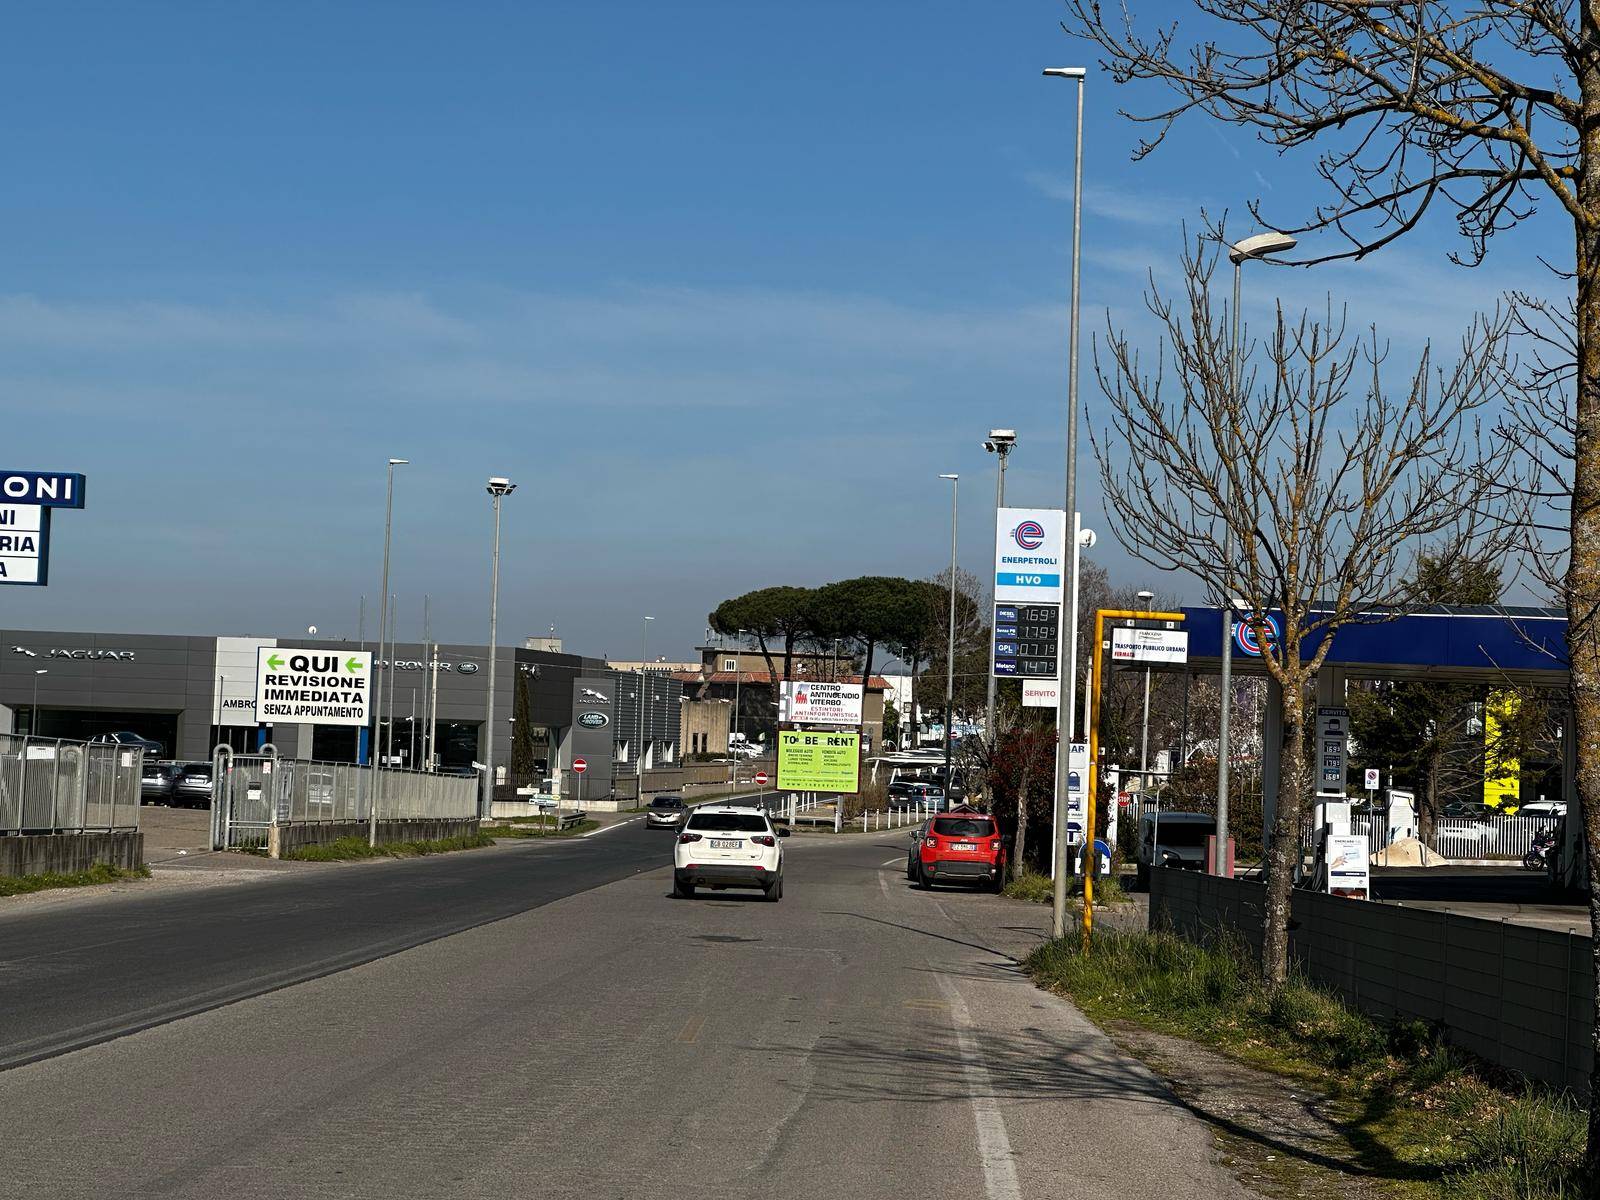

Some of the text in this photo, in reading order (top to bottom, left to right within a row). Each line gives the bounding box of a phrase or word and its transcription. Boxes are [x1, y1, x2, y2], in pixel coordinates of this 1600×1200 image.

[4, 476, 72, 499] ONI
[0, 536, 35, 552] RIA
[1002, 557, 1057, 565] ENERPETROLI
[1016, 575, 1041, 584] HVO
[42, 648, 135, 661] JAGUAR
[289, 655, 338, 673] QUI
[265, 674, 365, 689] REVISIONE
[264, 689, 363, 704] IMMEDIATA
[810, 692, 859, 700] ANTINCENDIO
[264, 704, 364, 718] SENZA APPUNTAMENTO
[794, 710, 859, 718] ANTINFORTUNISTICA
[783, 735, 854, 746] TO BE RENT
[1069, 745, 1085, 753] AR
